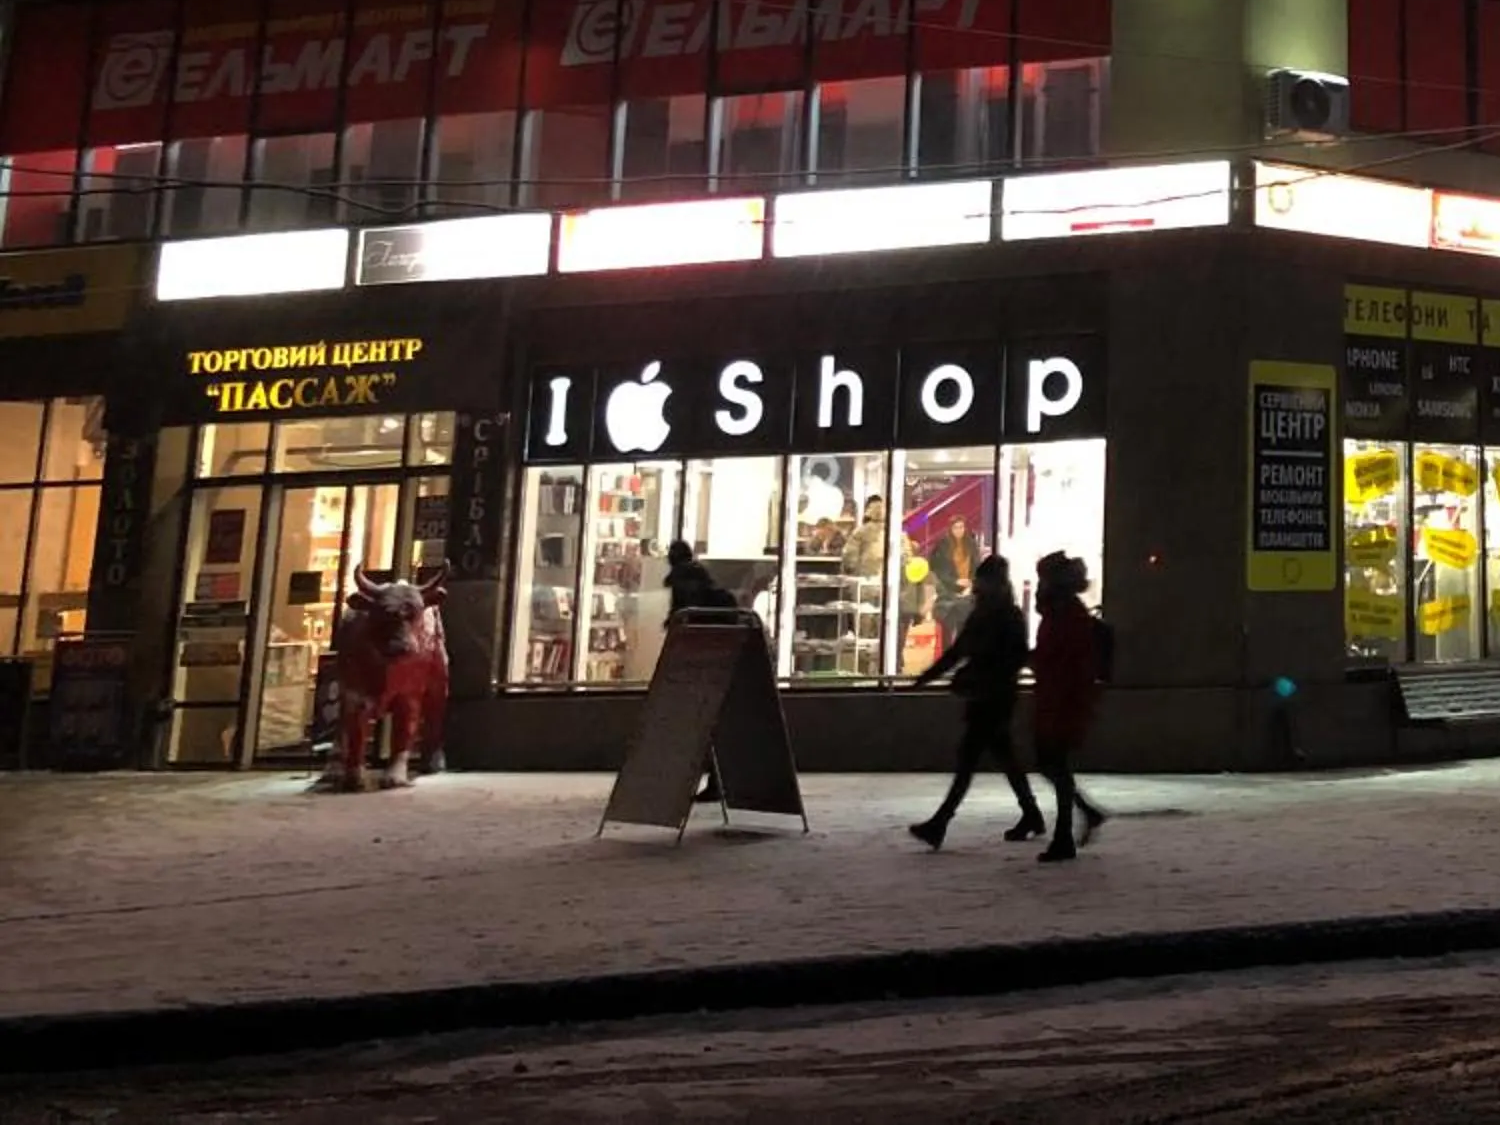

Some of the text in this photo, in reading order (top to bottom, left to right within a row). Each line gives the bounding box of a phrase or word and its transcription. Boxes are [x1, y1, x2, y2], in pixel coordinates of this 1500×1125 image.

[172, 22, 490, 105] ЕЛЬМАРТ
[188, 337, 424, 374] ТОРГОВИЙ ЦЕНТР
[1345, 345, 1401, 372] IPHONE
[1260, 409, 1327, 445] ЦЕНТР
[1259, 463, 1325, 488] РЕМОНТ
